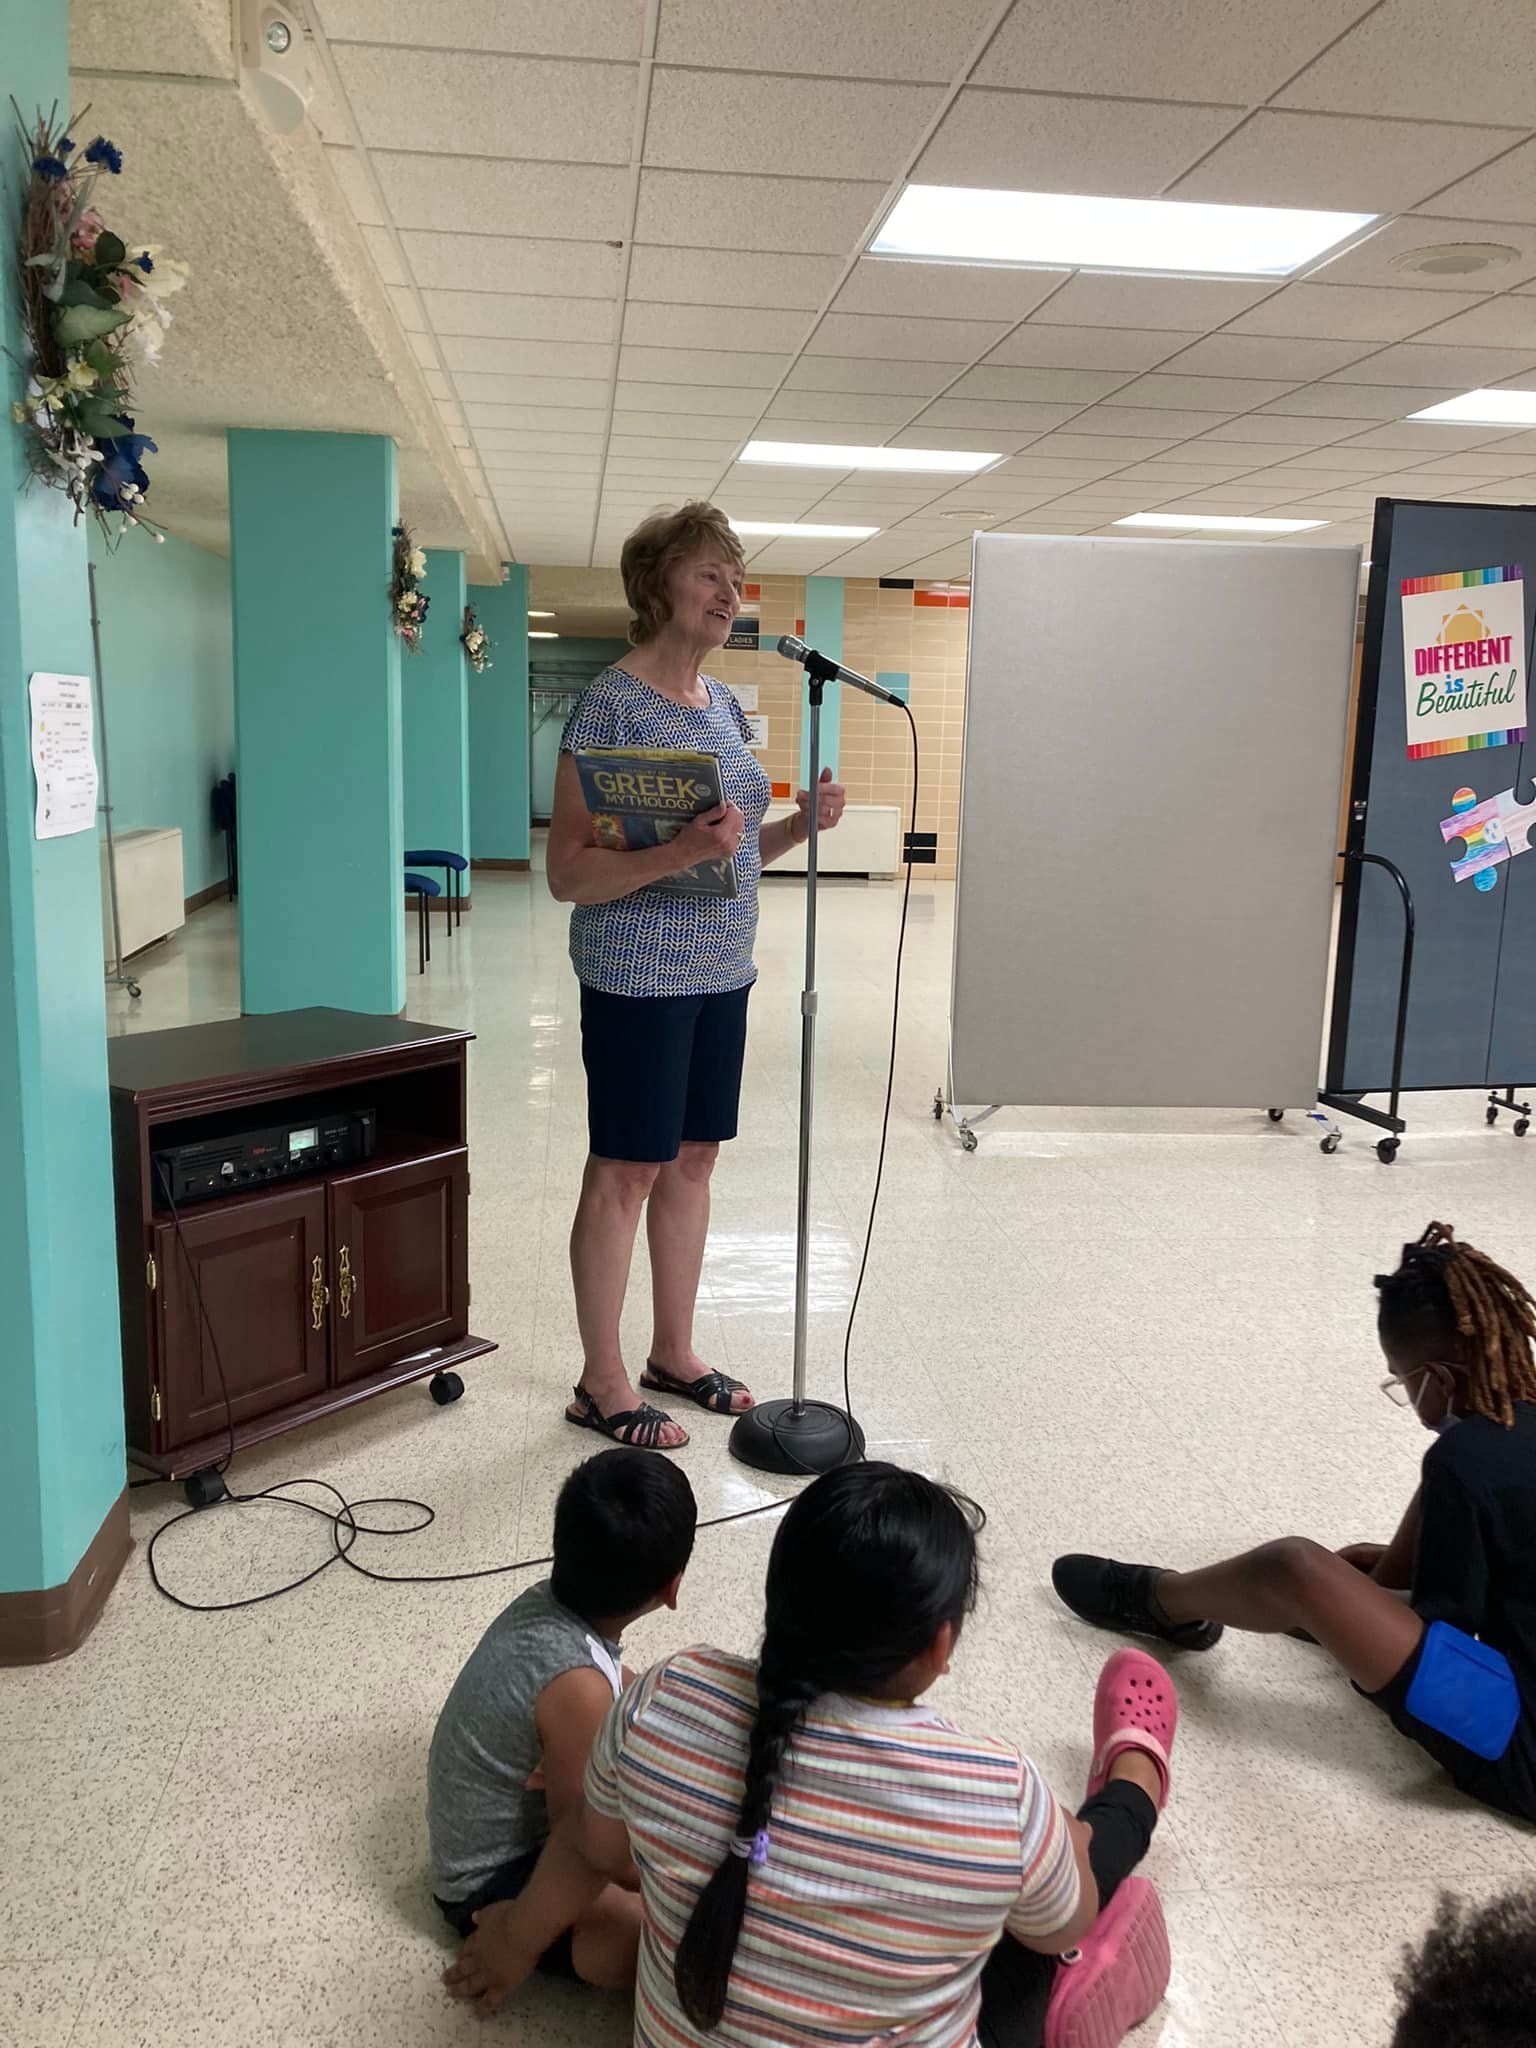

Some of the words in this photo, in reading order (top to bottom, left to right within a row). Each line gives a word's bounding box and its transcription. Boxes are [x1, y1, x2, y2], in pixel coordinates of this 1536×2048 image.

[729, 636, 753, 644] LADIES
[1414, 635, 1512, 676] DIFFERENT
[1416, 668, 1518, 717] Beautiful
[1444, 674, 1465, 694] is
[593, 771, 699, 800] GREEK
[604, 794, 696, 811] MYTHOLOGY
